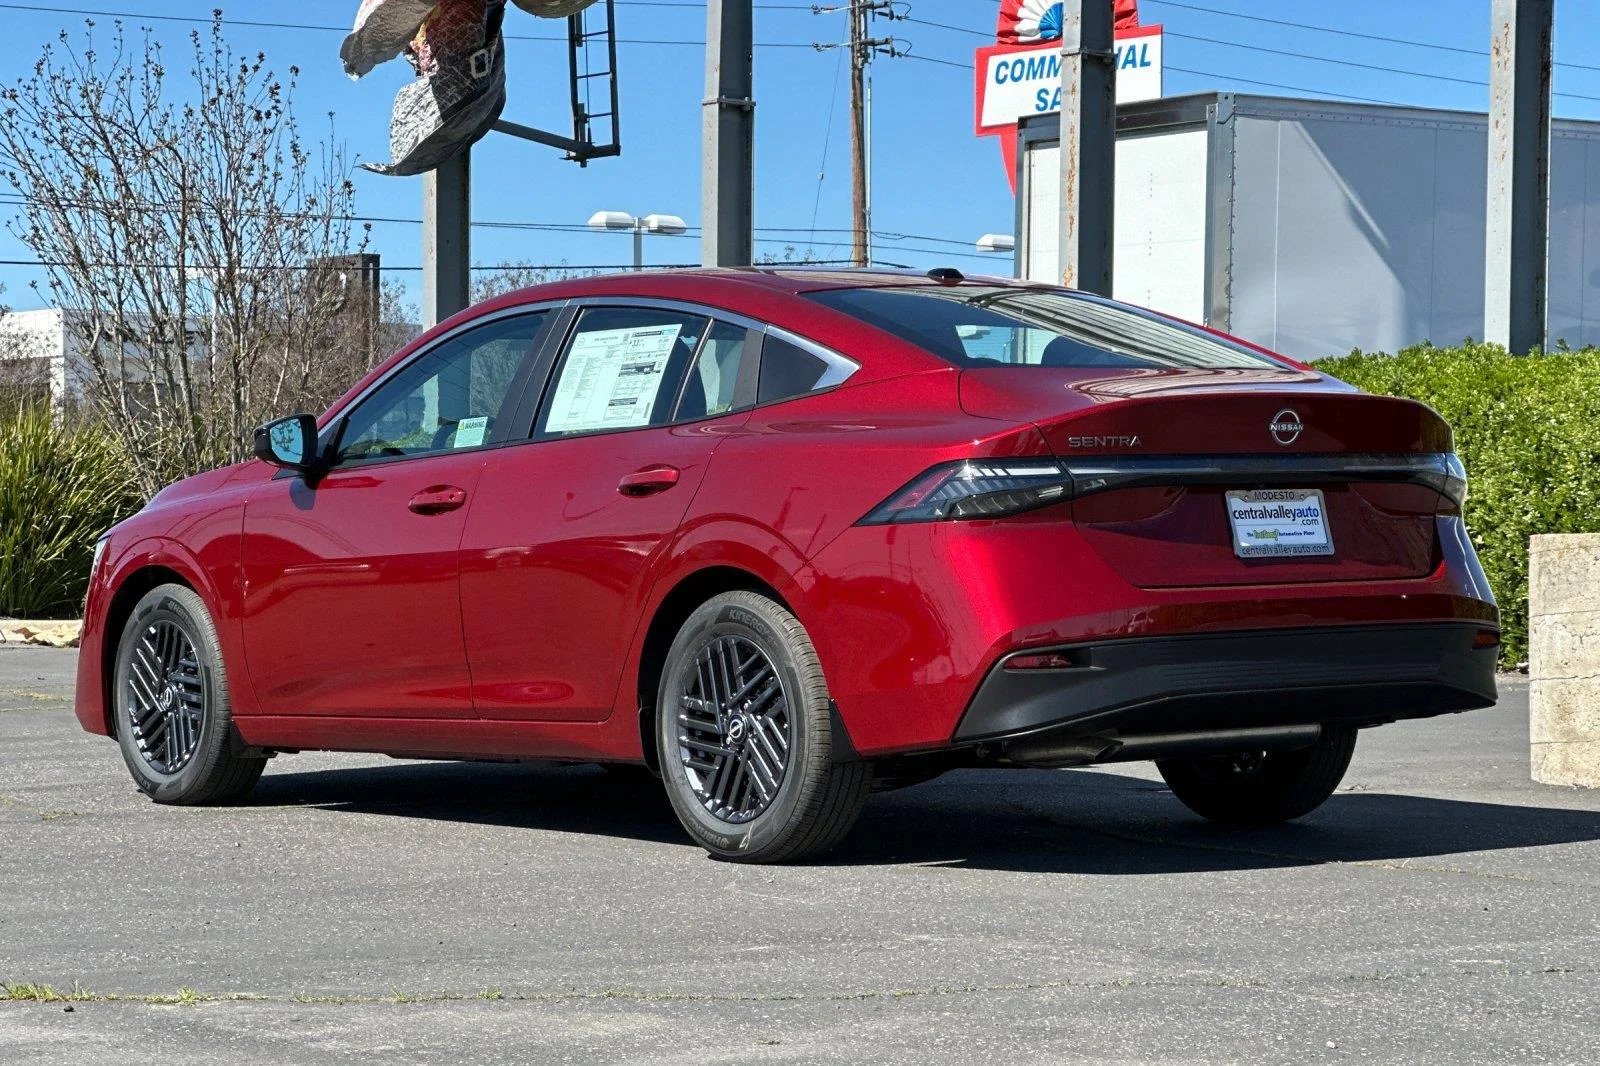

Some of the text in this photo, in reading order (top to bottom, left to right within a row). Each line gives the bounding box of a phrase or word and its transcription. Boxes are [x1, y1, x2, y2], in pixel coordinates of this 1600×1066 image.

[995, 43, 1152, 84] COMMIAL
[1269, 422, 1304, 431] NISSAN
[1068, 435, 1142, 447] SENTRA
[1255, 491, 1295, 500] MODESTO
[1233, 505, 1319, 521] centralvalleyauto
[1300, 518, 1319, 526] .com
[1241, 544, 1329, 556] centralvalleyauto.com
